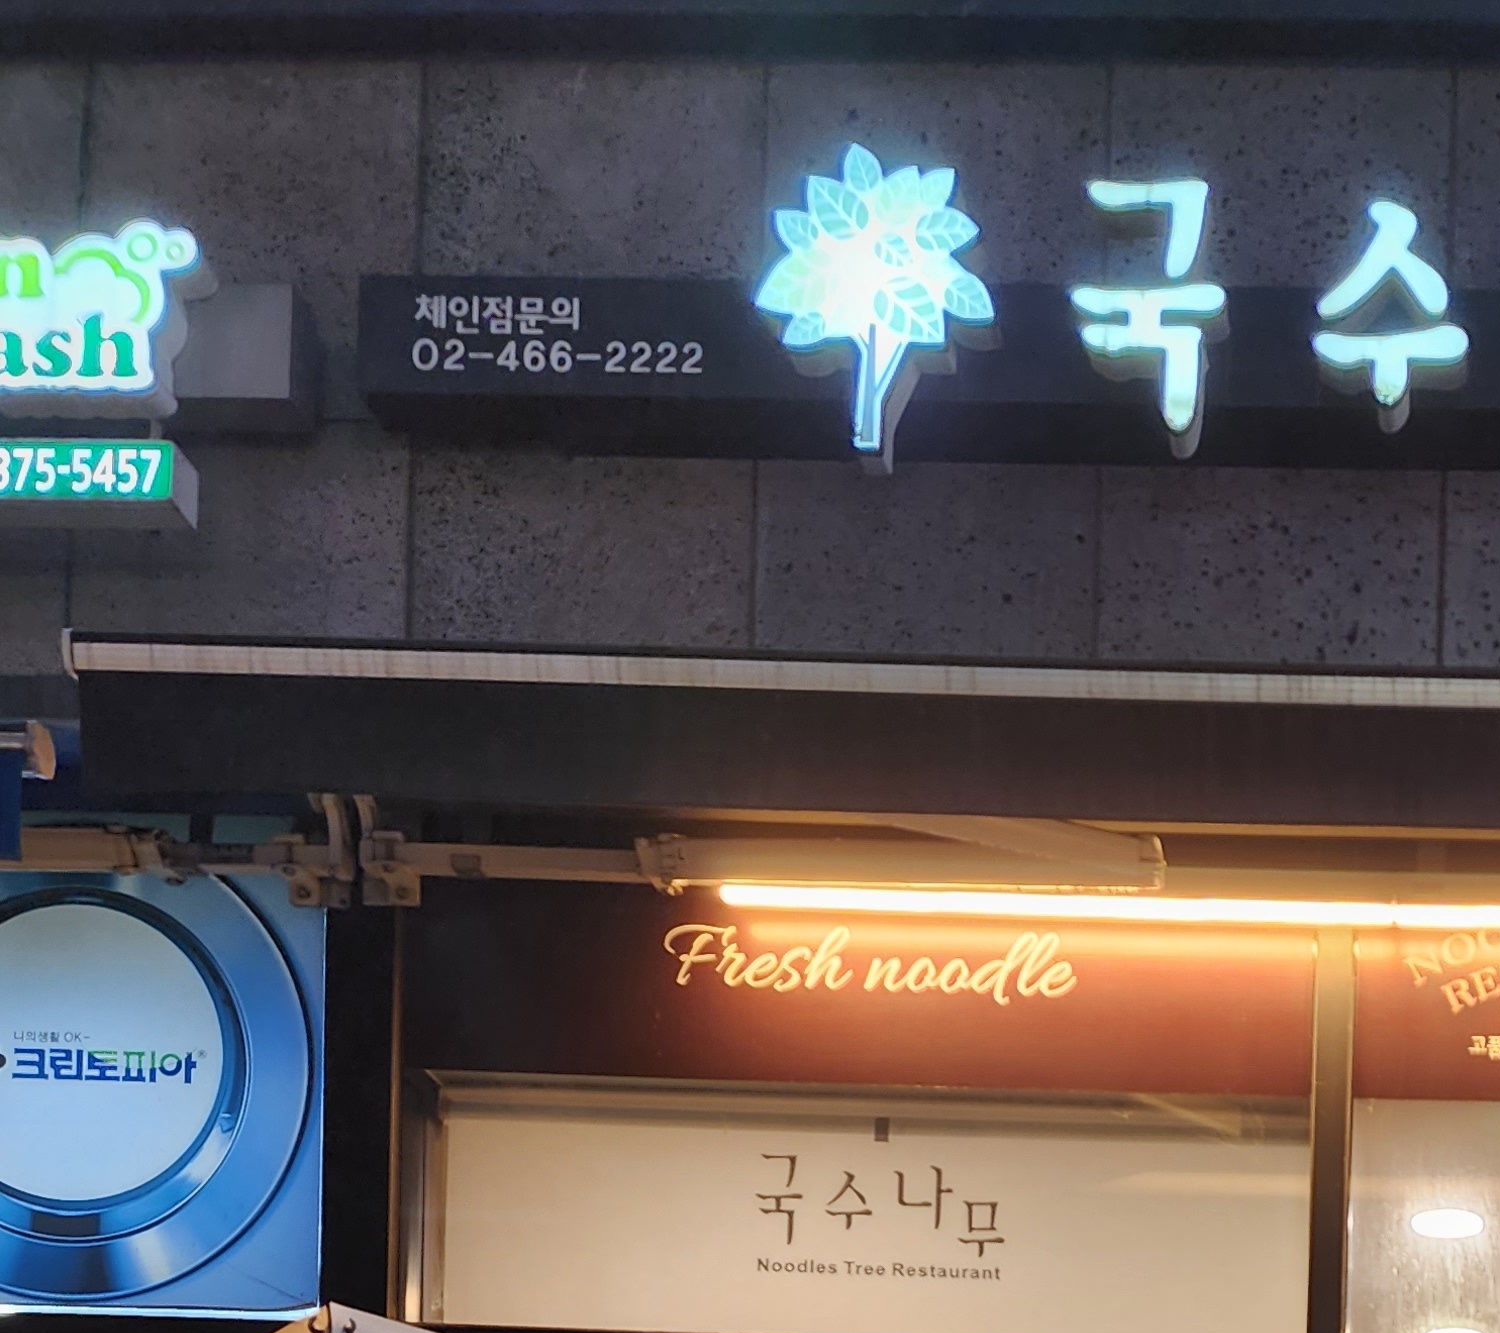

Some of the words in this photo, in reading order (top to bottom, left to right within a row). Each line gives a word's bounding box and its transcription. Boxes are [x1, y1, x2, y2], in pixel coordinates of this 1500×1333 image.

[413, 294, 582, 333] 체인점문의
[411, 337, 704, 375] 02-466-2222
[663, 923, 855, 993] Fresh
[863, 930, 1078, 1006] noodle
[12, 1047, 198, 1085] 크린토피아
[755, 1152, 1006, 1258] 국수나무
[756, 1257, 838, 1276] Noodles
[843, 1260, 887, 1277] Tree
[891, 1261, 1002, 1281] Restaurant
